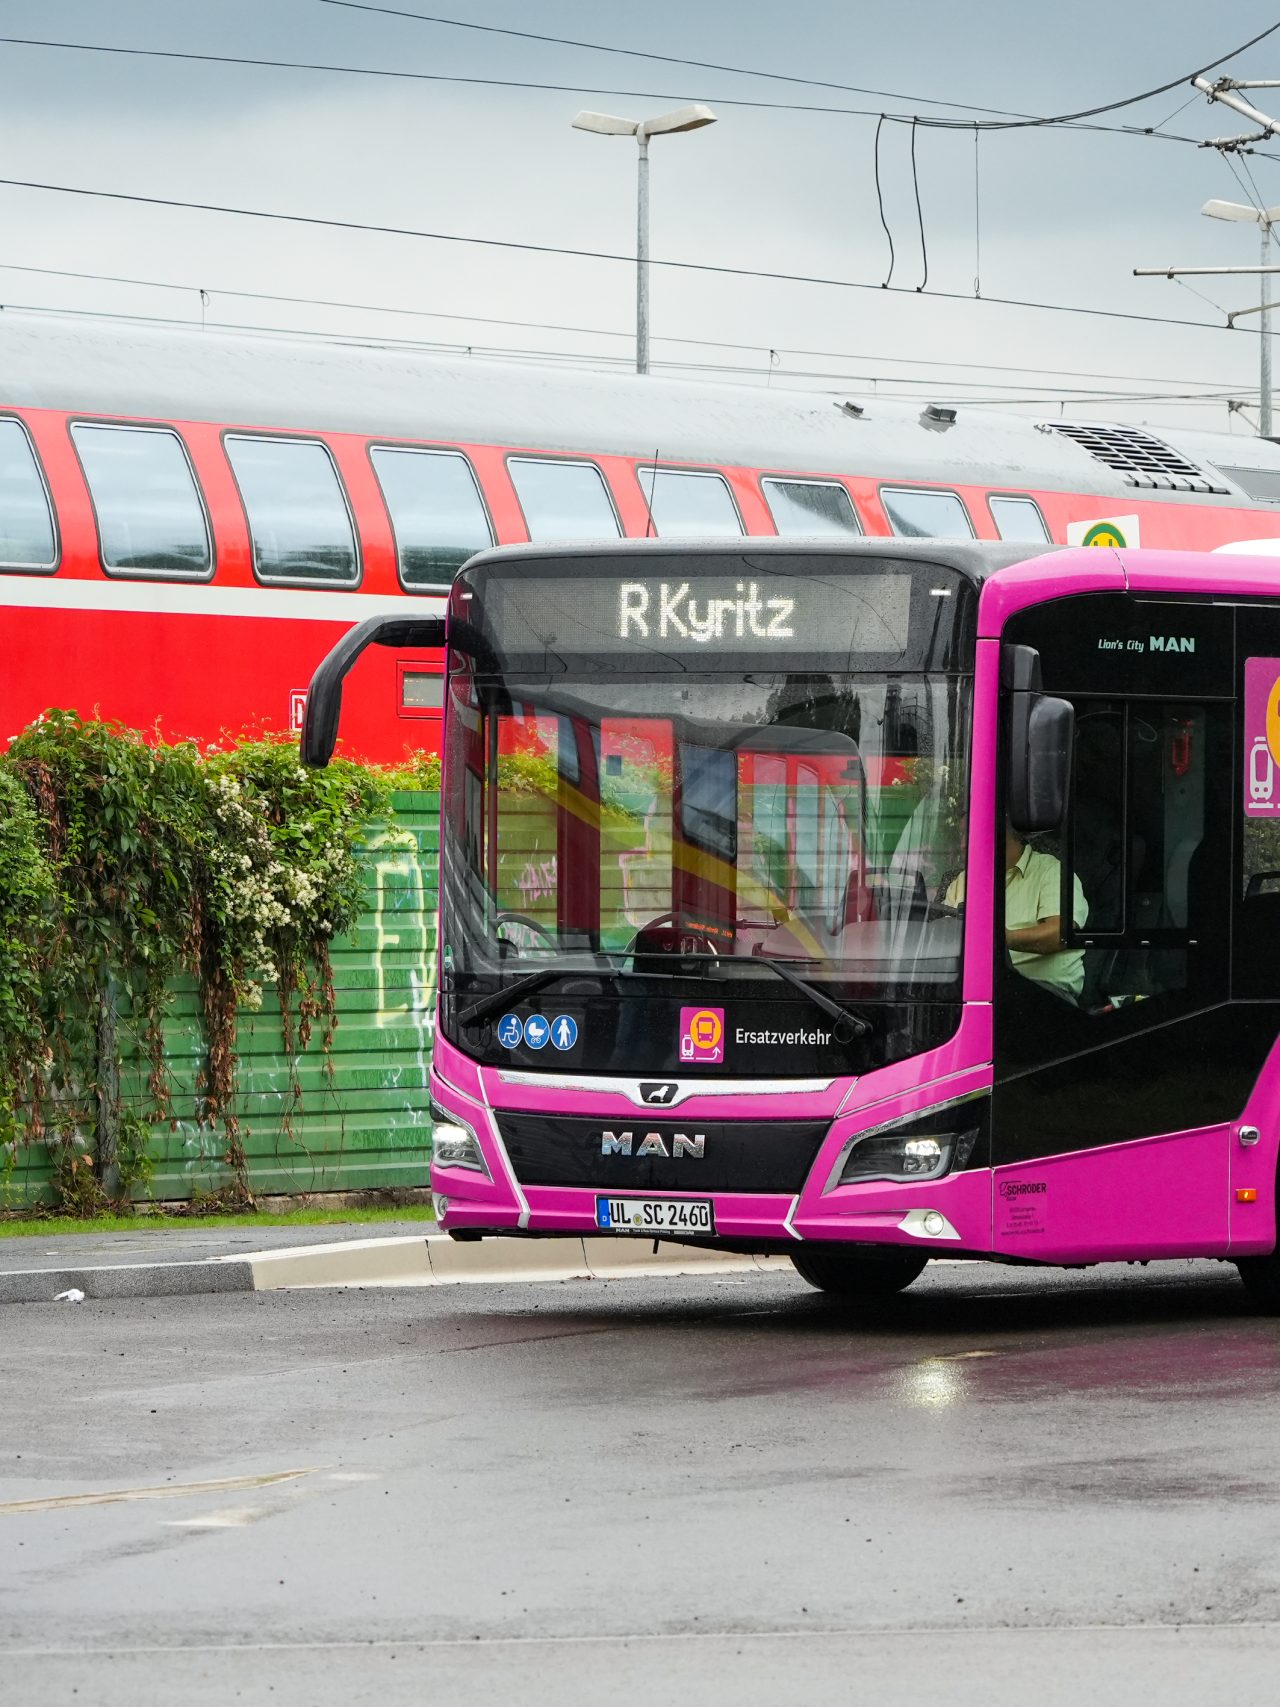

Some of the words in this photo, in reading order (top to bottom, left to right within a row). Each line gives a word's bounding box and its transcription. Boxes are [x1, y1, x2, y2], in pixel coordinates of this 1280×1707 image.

[619, 583, 649, 638] R
[660, 582, 795, 642] Kyritz
[1098, 639, 1124, 650] Lion's
[1126, 640, 1145, 653] City
[1149, 636, 1195, 652] MAN
[735, 1028, 832, 1045] Ersatzverkehr
[601, 1131, 706, 1159] MAN
[610, 1202, 632, 1224] UL
[643, 1203, 664, 1225] SC
[668, 1204, 709, 1227] 2460
